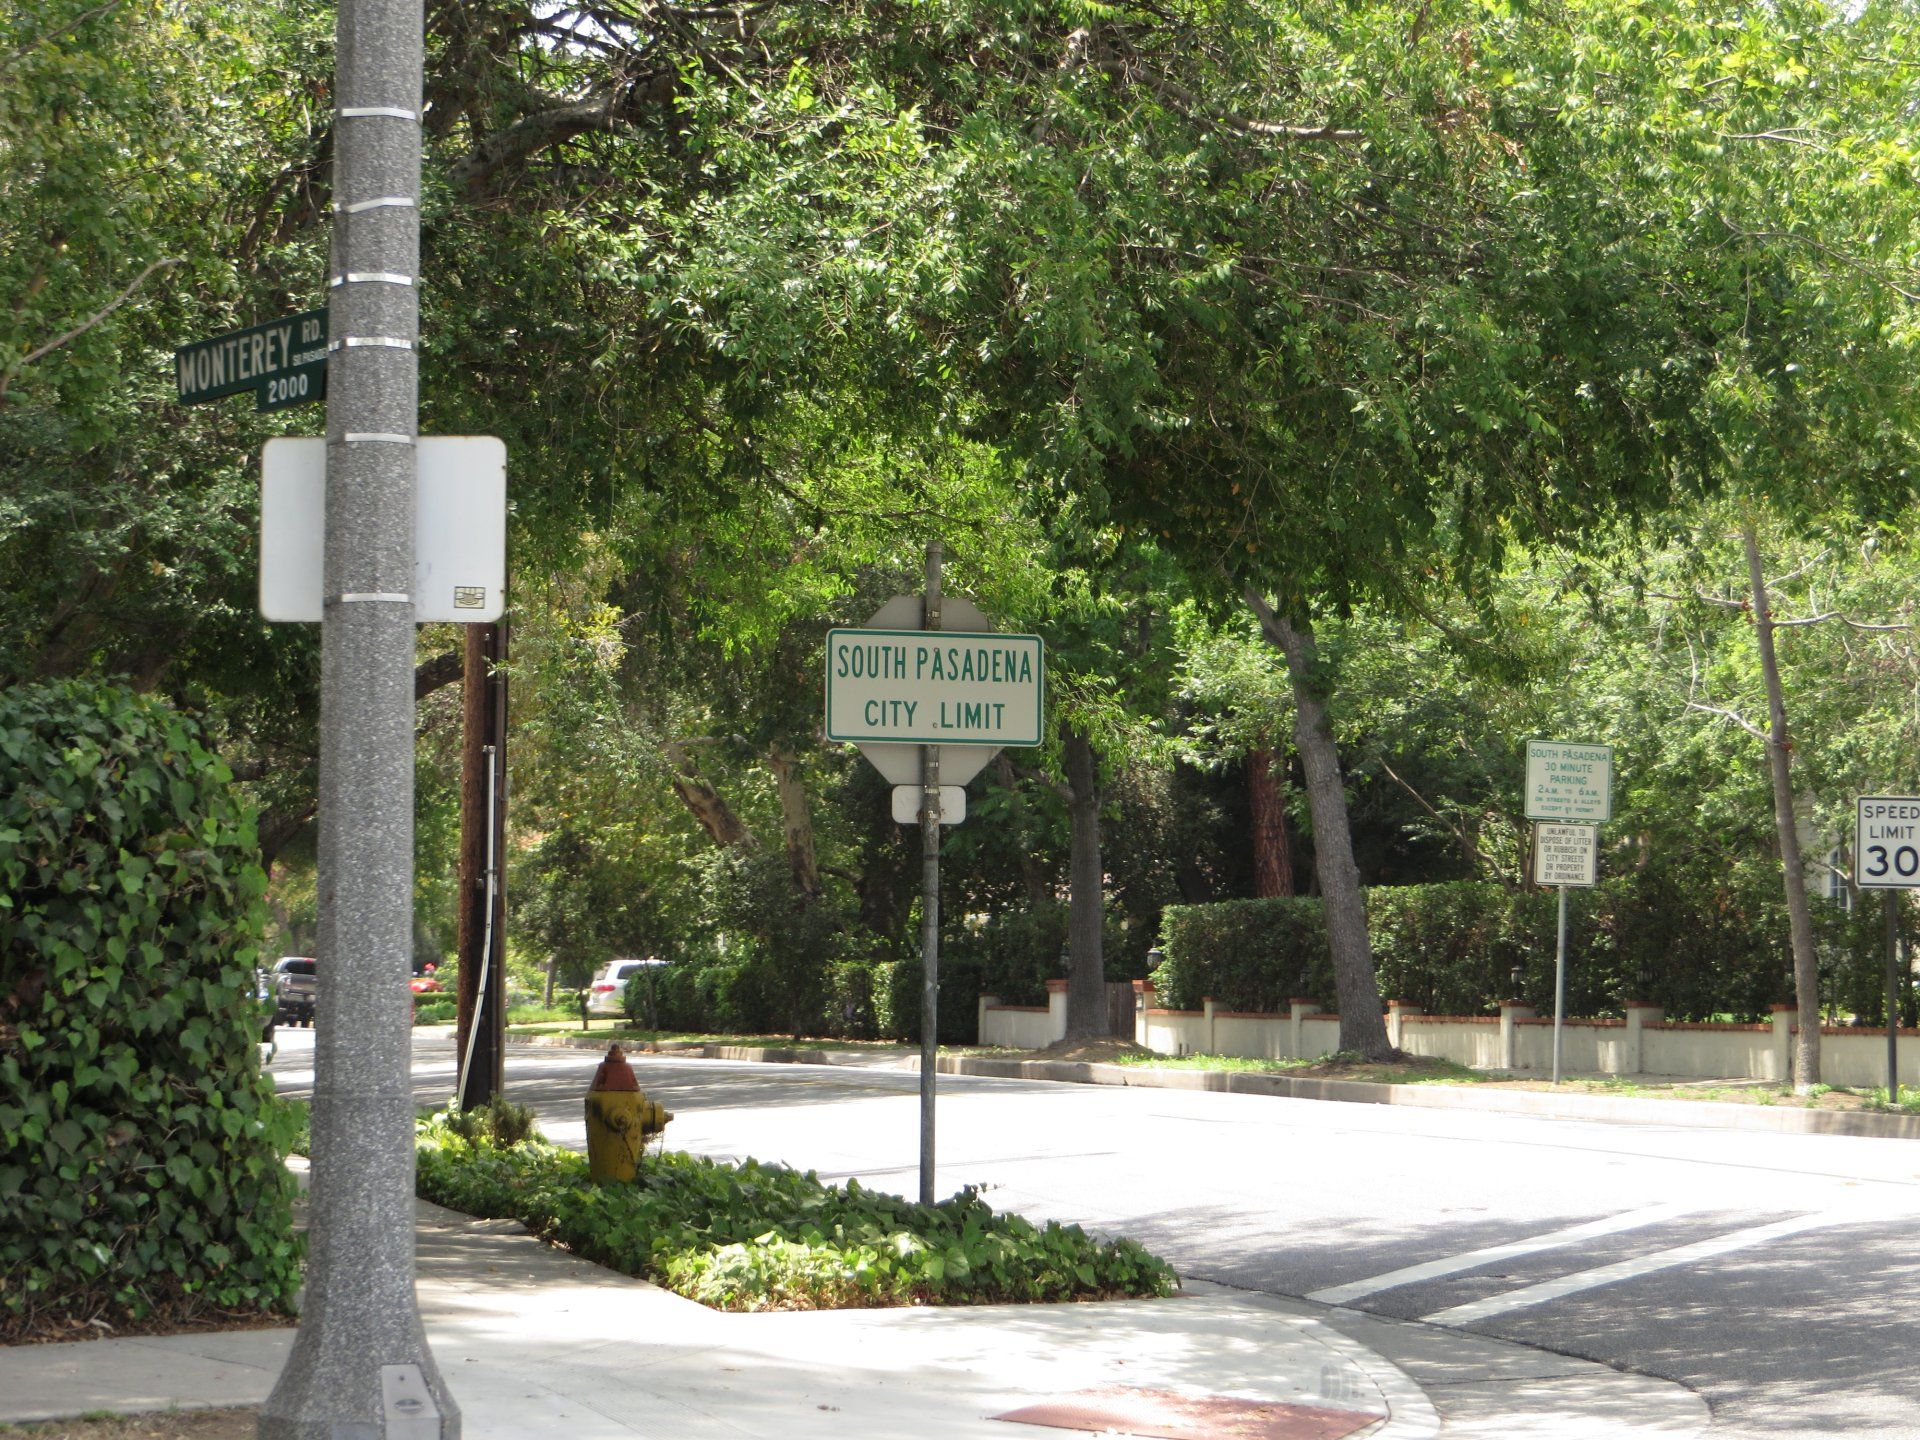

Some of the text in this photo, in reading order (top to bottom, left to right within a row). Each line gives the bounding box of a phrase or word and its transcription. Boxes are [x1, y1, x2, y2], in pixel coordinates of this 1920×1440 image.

[179, 324, 292, 396] MONTEREY
[302, 319, 324, 344] RD.
[268, 373, 309, 403] 2000
[837, 644, 1032, 684] SOUTH PASADENA
[864, 699, 1006, 730] CITY LIMIT
[1530, 748, 1608, 762] SOUTH PASADENA
[1544, 762, 1593, 774] 30 MINUTE
[1550, 774, 1588, 785] PARKING
[1864, 805, 1920, 819] SPEED
[1546, 827, 1576, 836] UNLAWFUL
[1869, 825, 1915, 839] LIMIT
[1540, 836, 1563, 845] DISPOSE
[1574, 837, 1592, 846] LITTER
[1546, 854, 1585, 863] CITY STREETS
[1865, 845, 1919, 877] 30
[1556, 863, 1585, 872] PROPERTY
